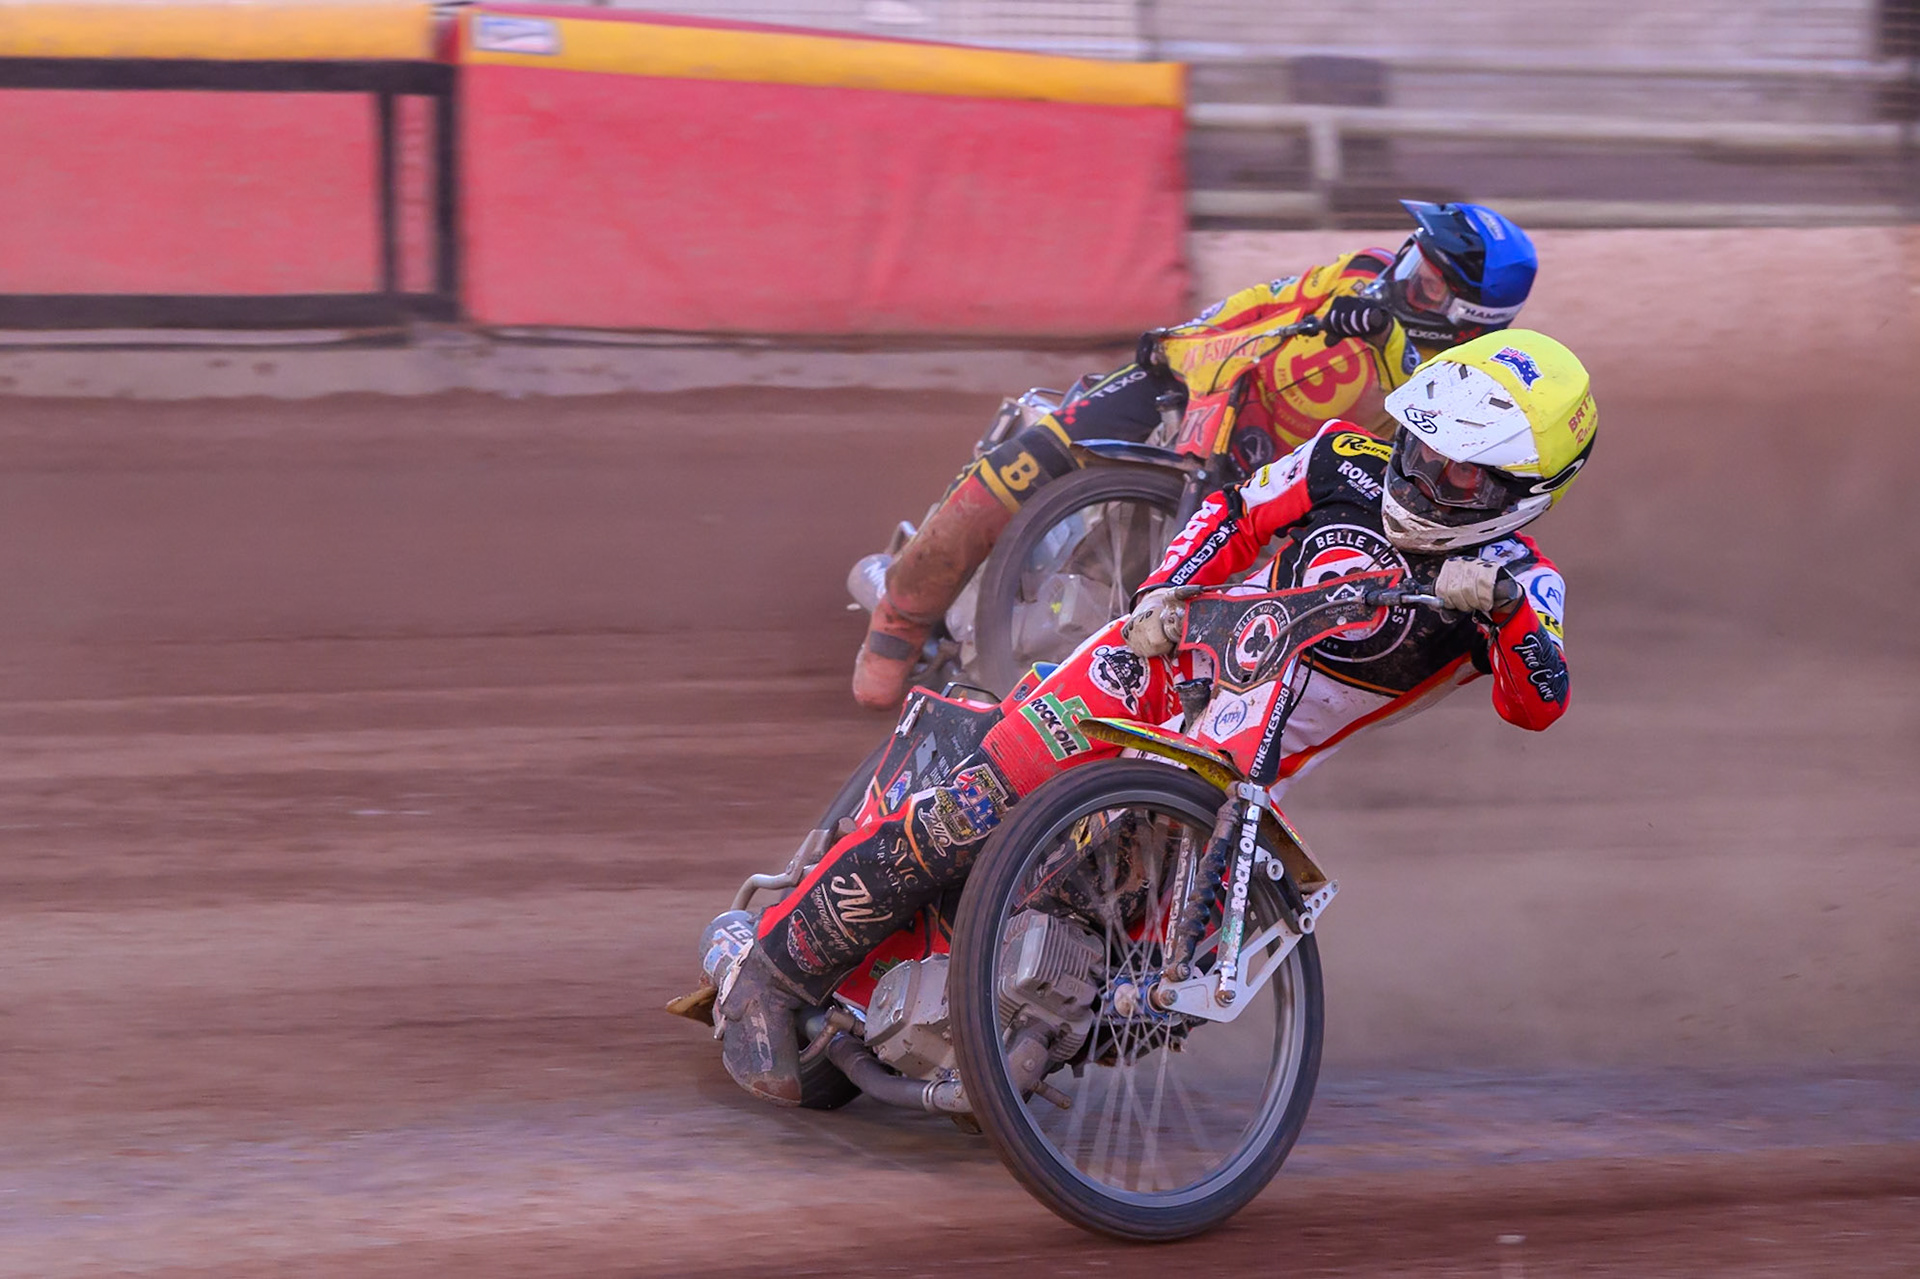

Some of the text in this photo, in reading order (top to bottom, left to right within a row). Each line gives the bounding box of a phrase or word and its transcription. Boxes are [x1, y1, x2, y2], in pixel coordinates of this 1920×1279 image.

[1000, 451, 1040, 491] B
[1337, 460, 1384, 498] ROWE
[1315, 531, 1367, 549] BELLE
[1234, 604, 1287, 638] BELLE VUE ACE
[1513, 633, 1543, 669] Tree
[1529, 668, 1556, 701] Care
[1030, 698, 1079, 757] ROCK OIL
[1231, 822, 1259, 912] ROCK OIL
